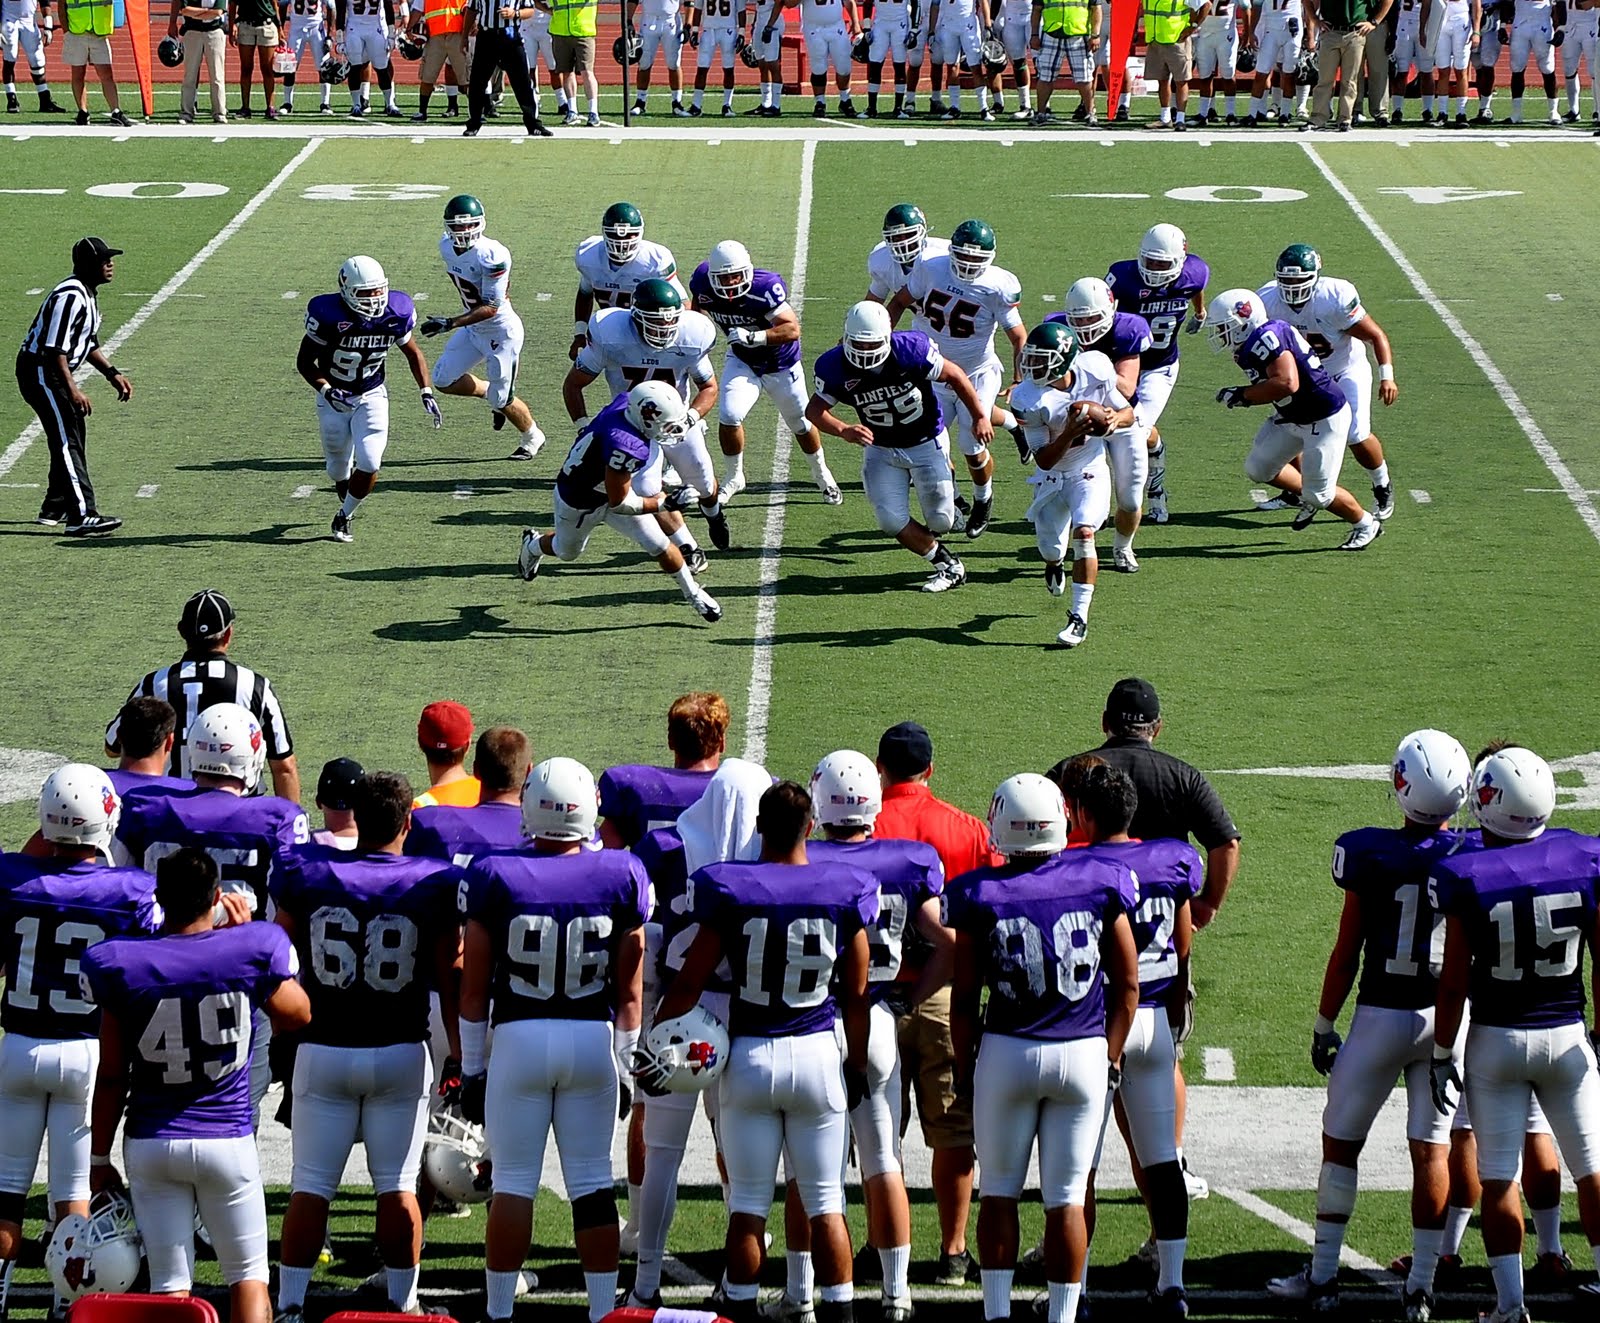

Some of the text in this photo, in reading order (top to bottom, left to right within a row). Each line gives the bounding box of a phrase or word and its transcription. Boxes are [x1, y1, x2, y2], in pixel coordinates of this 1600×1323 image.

[764, 282, 786, 308] 19
[926, 288, 981, 338] 56
[339, 335, 395, 349] LINFIELD
[1251, 330, 1281, 360] 50
[330, 349, 387, 382] 92
[854, 381, 914, 406] LINFIELD
[863, 387, 924, 427] 59
[608, 450, 640, 472] 24
[456, 879, 469, 912] 6
[1427, 877, 1439, 909] 5
[310, 905, 418, 993] 68
[508, 915, 613, 1000] 96
[992, 911, 1103, 1002] 98
[1135, 897, 1179, 983] 2
[1490, 892, 1582, 981] 15
[8, 916, 105, 1015] 13
[740, 917, 837, 1008] 18
[138, 991, 251, 1084] 49
